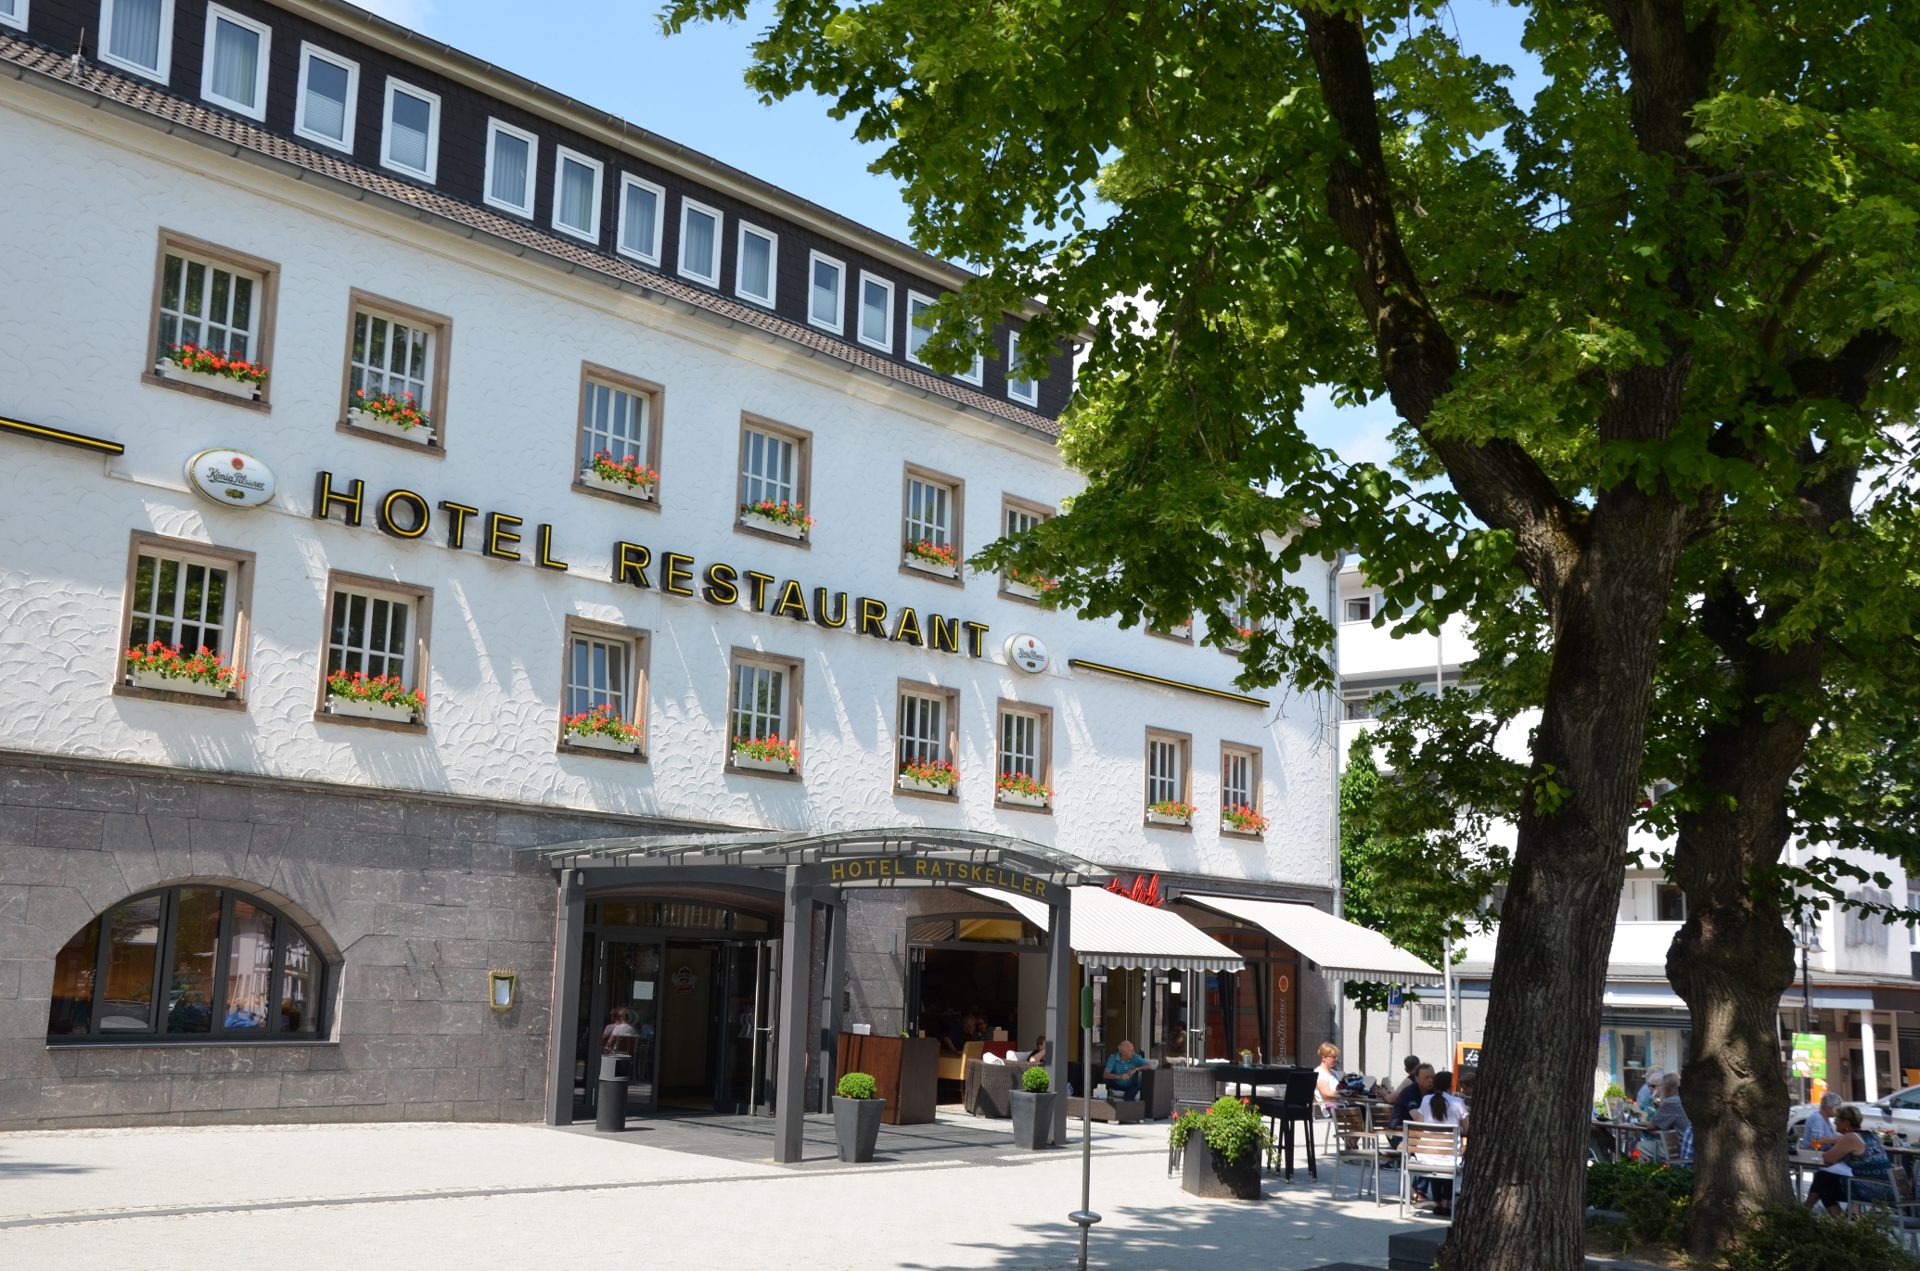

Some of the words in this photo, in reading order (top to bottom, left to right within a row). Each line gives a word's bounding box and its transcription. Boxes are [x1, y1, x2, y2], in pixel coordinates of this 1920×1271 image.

[206, 467, 234, 484] König
[312, 470, 568, 571] HOTEL
[612, 540, 990, 658] RESTAURANT
[831, 859, 905, 881] HOTEL
[915, 860, 1046, 898] RATSKELLER
[1392, 989, 1400, 1003] P
